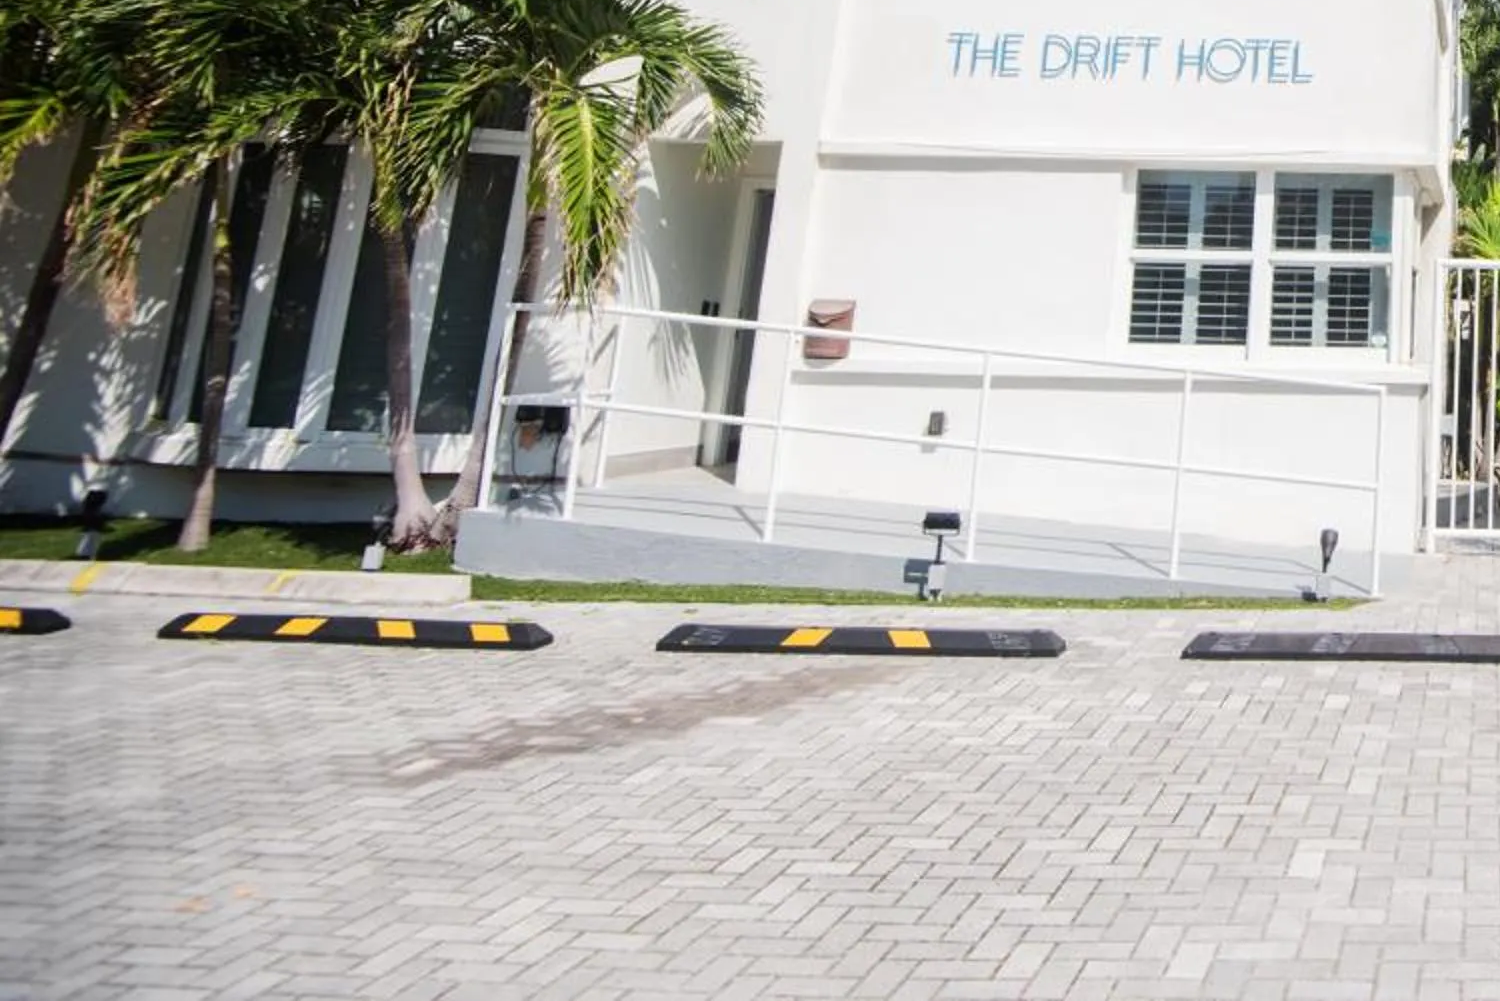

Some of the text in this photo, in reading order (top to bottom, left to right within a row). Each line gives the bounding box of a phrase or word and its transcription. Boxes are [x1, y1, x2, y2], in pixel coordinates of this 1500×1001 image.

[947, 32, 1313, 84] THE DRIFT HOTEL
